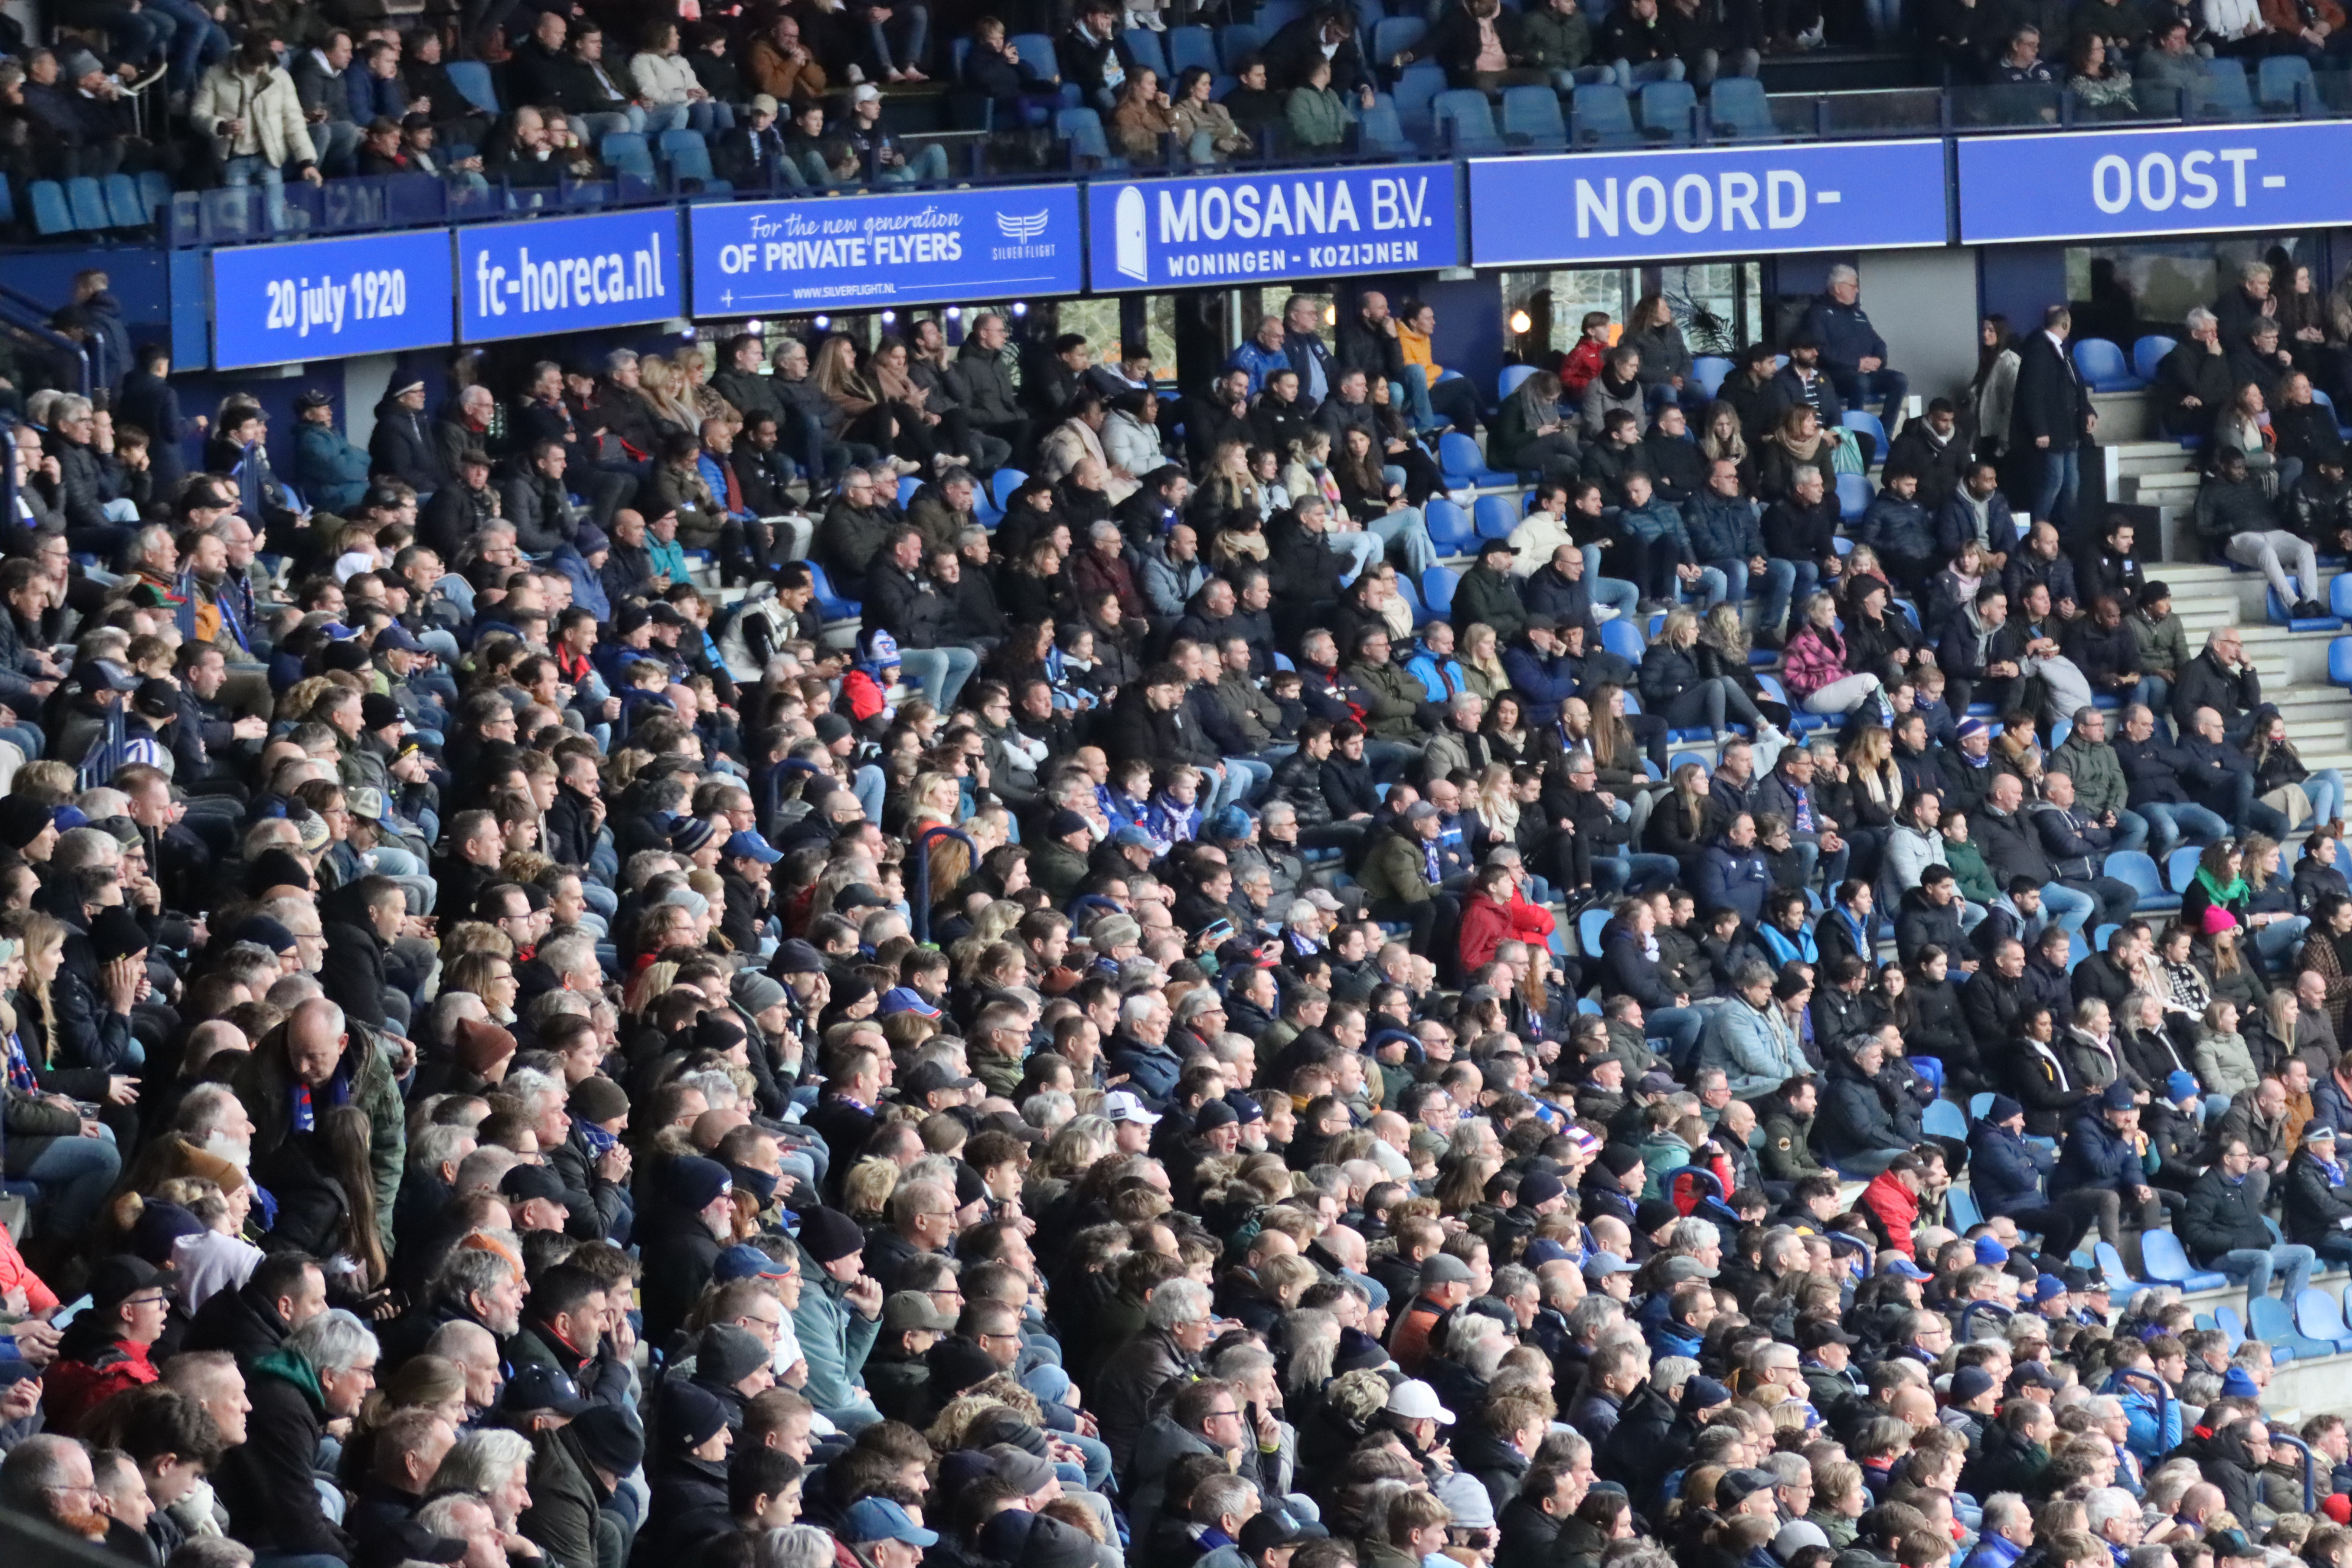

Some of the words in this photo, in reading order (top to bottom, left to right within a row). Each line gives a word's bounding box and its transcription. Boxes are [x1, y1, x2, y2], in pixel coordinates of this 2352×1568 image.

[1159, 180, 1360, 243] MOSANA
[1371, 177, 1432, 230] B.V.
[1575, 170, 1841, 238] NOORD-
[2092, 148, 2286, 214] OOST-
[720, 243, 757, 274] OF
[764, 237, 868, 271] PRIVATE
[875, 232, 962, 265] FLYERS
[749, 214, 782, 239] For
[785, 213, 820, 237] the
[823, 218, 857, 235] new
[861, 205, 963, 246] generation
[477, 232, 665, 317] fc-horeca.nl
[793, 283, 897, 299] WWW.SILVERFLIGHT.NL
[1168, 250, 1286, 277] WONINGEN
[1310, 241, 1419, 268] KOZIJNEN
[267, 279, 296, 329] 20
[299, 276, 347, 337] july
[350, 268, 406, 320] 1920
